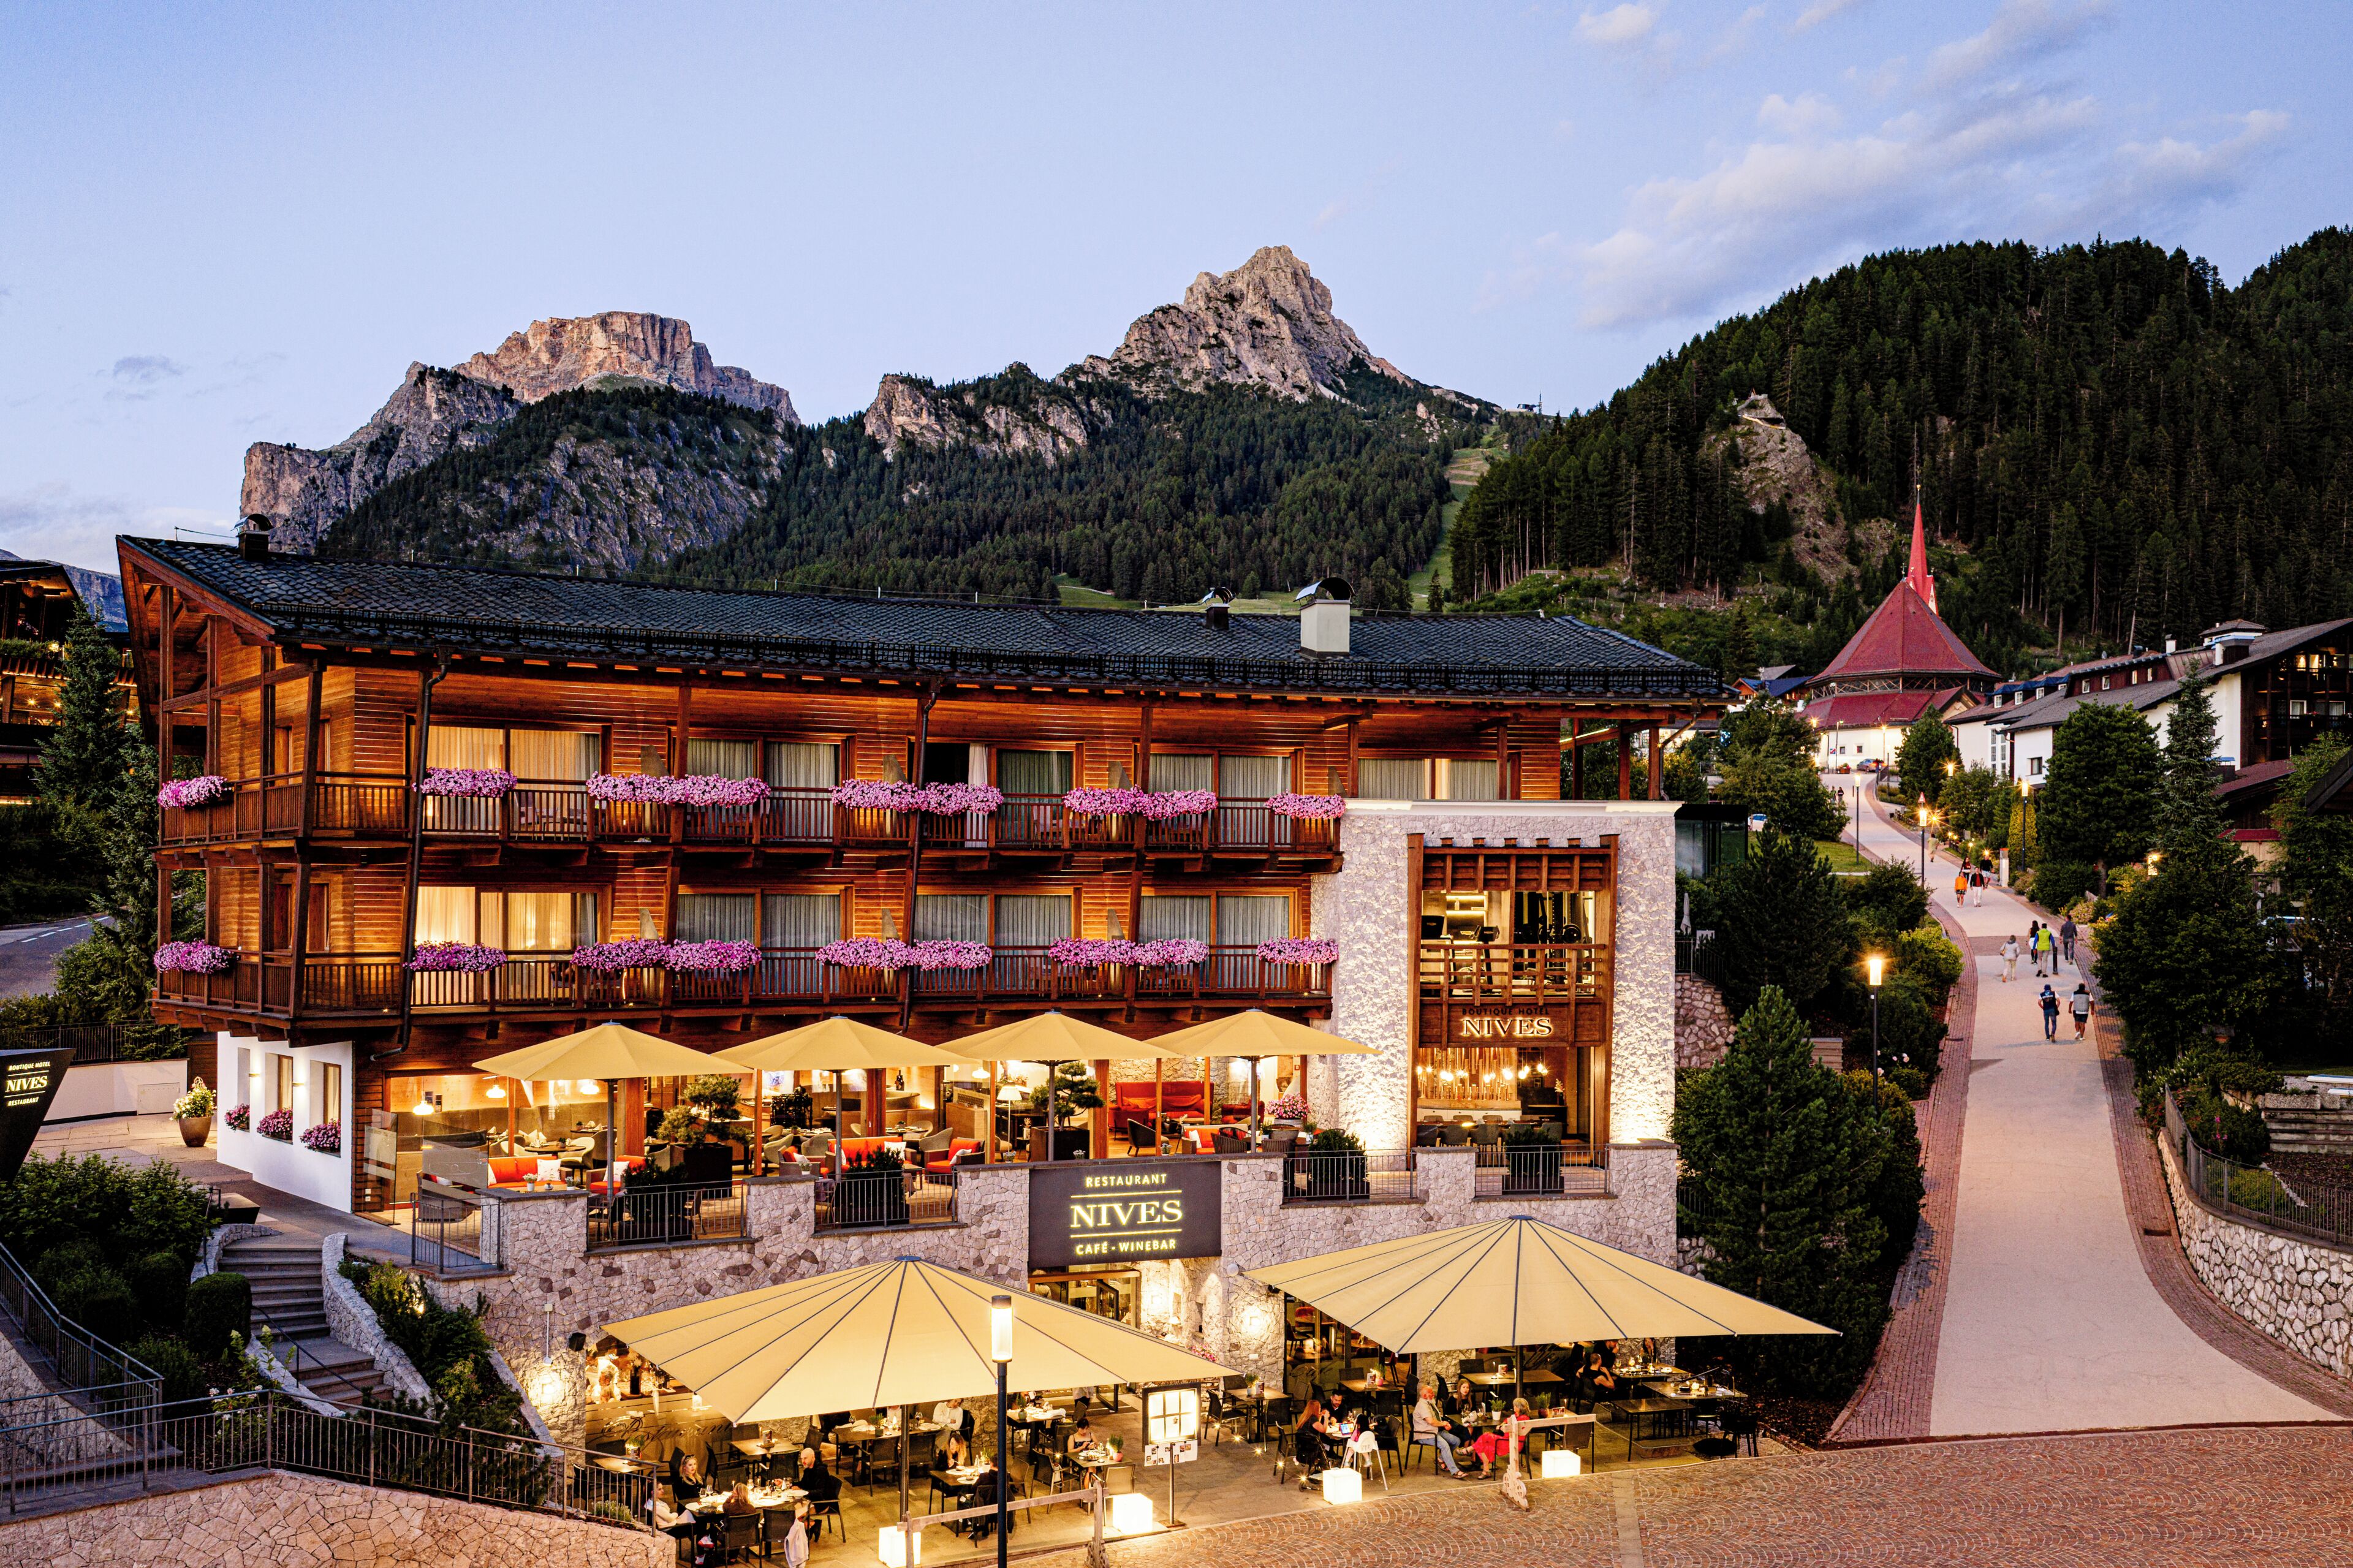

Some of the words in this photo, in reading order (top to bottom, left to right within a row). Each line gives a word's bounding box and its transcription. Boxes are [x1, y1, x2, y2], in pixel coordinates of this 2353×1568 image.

[1461, 1018, 1553, 1036] NIVES
[9, 1062, 34, 1071] BOUTIQUE
[5, 1075, 48, 1093] NIVES
[7, 1096, 39, 1106] RESTAURANT
[1085, 1173, 1167, 1187] RESTAURANT
[1070, 1200, 1183, 1228] NIVES
[1076, 1241, 1108, 1256] CAFÉ
[1119, 1238, 1176, 1252] WINEBAR
